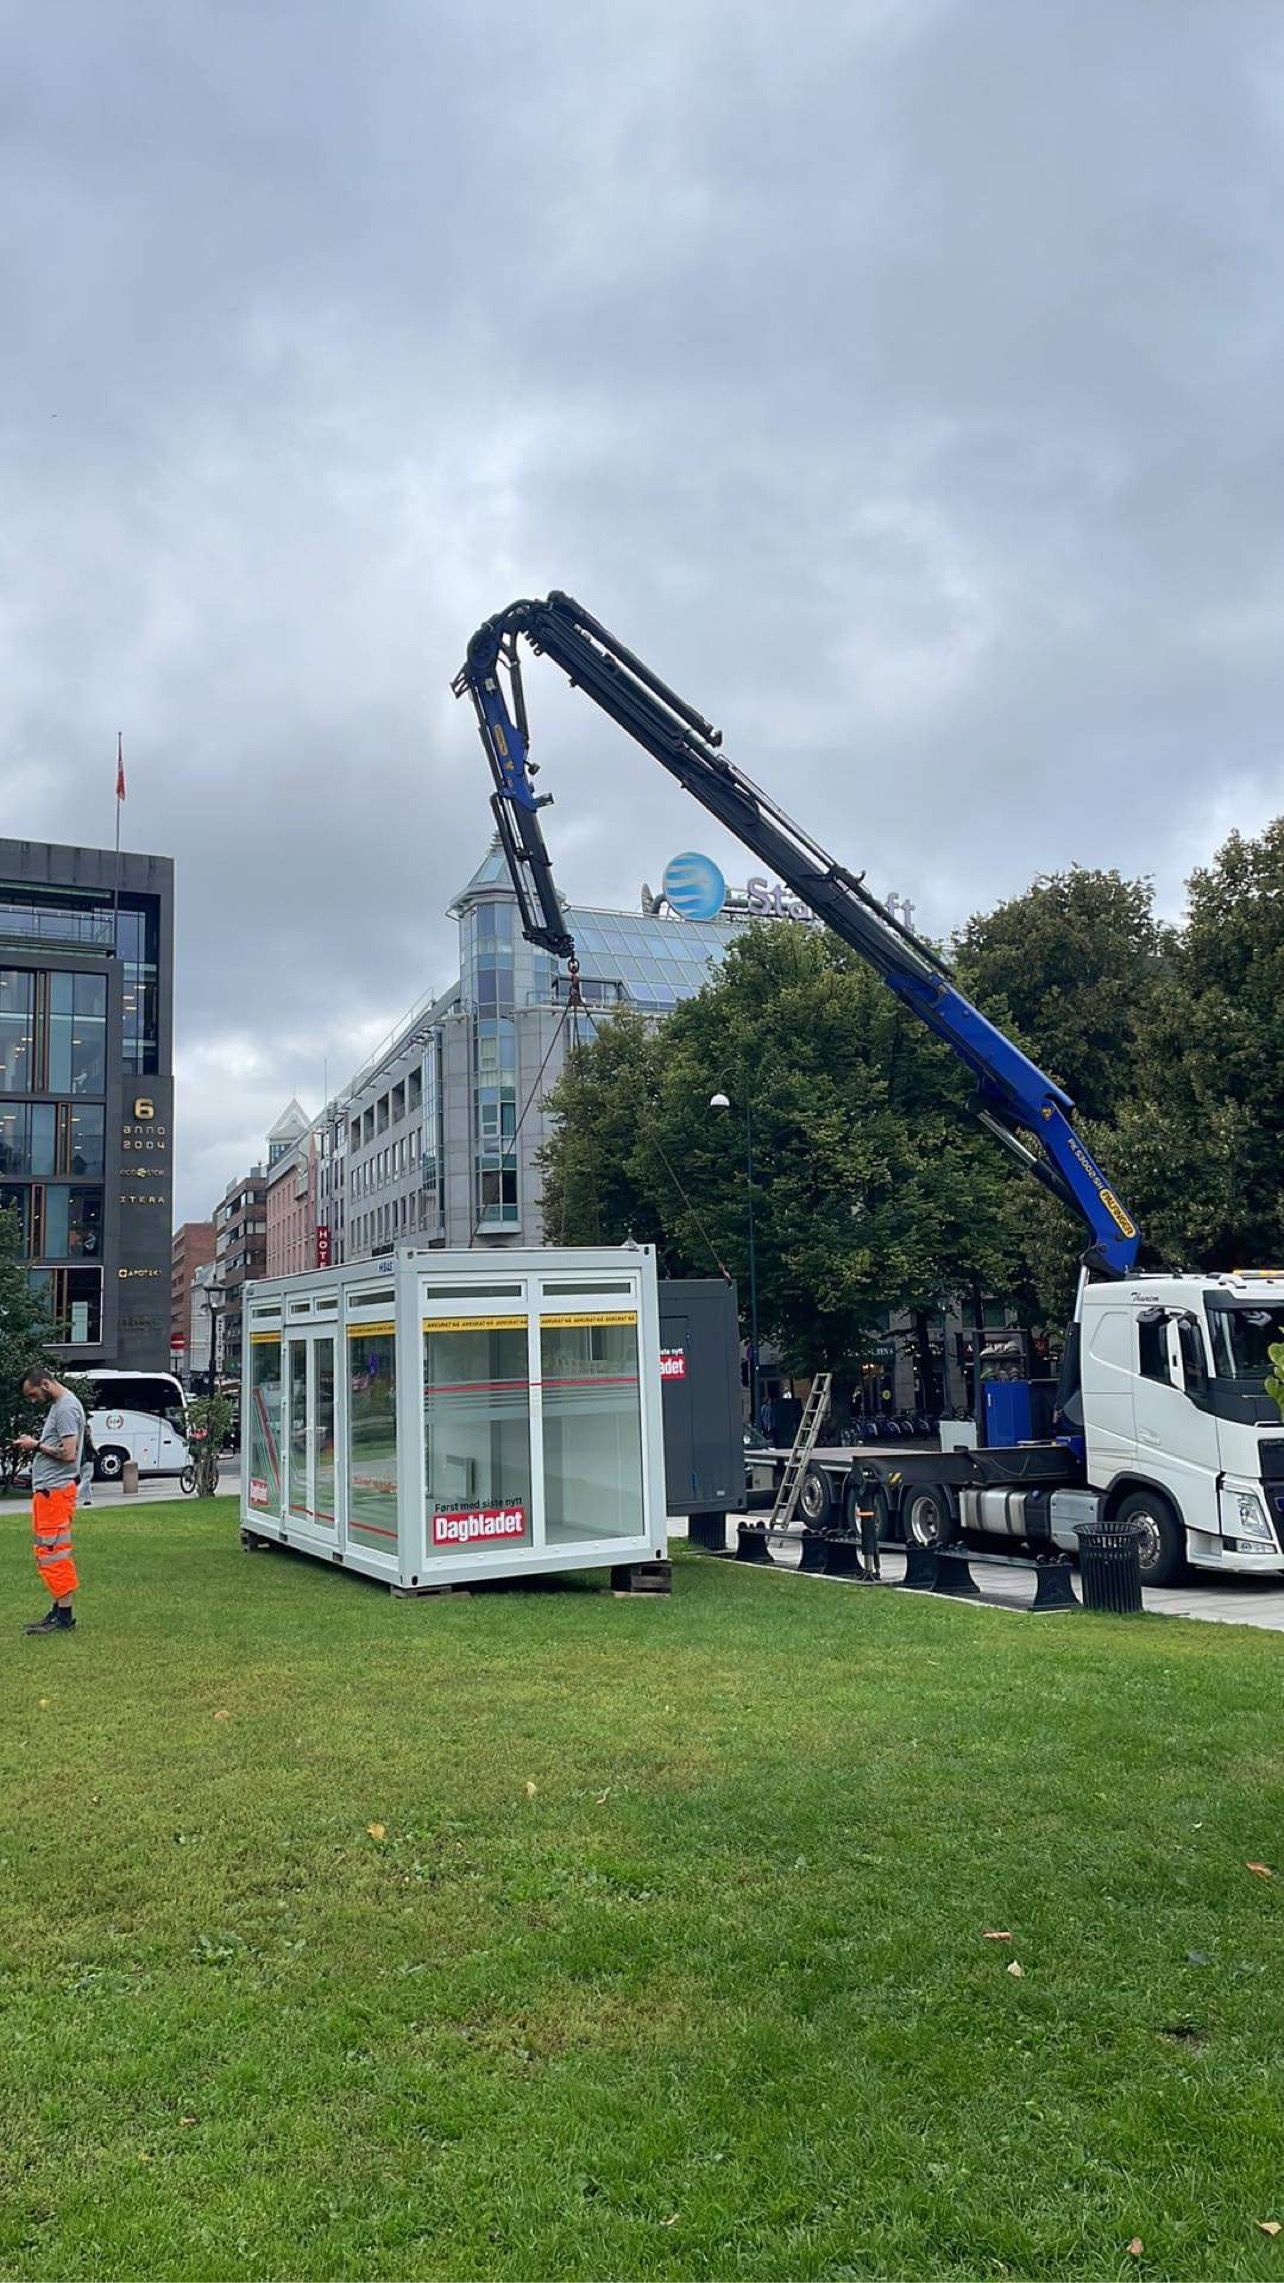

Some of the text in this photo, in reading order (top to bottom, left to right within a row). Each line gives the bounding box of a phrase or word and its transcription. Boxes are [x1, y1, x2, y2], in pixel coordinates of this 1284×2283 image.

[747, 876, 915, 932] Staft
[134, 1097, 154, 1120] 6
[123, 1125, 165, 1135] anno
[123, 1140, 165, 1149] 2004
[120, 1196, 165, 1205] ITERA
[1101, 1191, 1134, 1235] PALFINGER
[319, 1230, 328, 1269] HOTE
[435, 1502, 459, 1512] Først
[460, 1500, 480, 1510] med
[505, 1497, 522, 1507] nytt
[435, 1511, 523, 1542] Dagbladet
